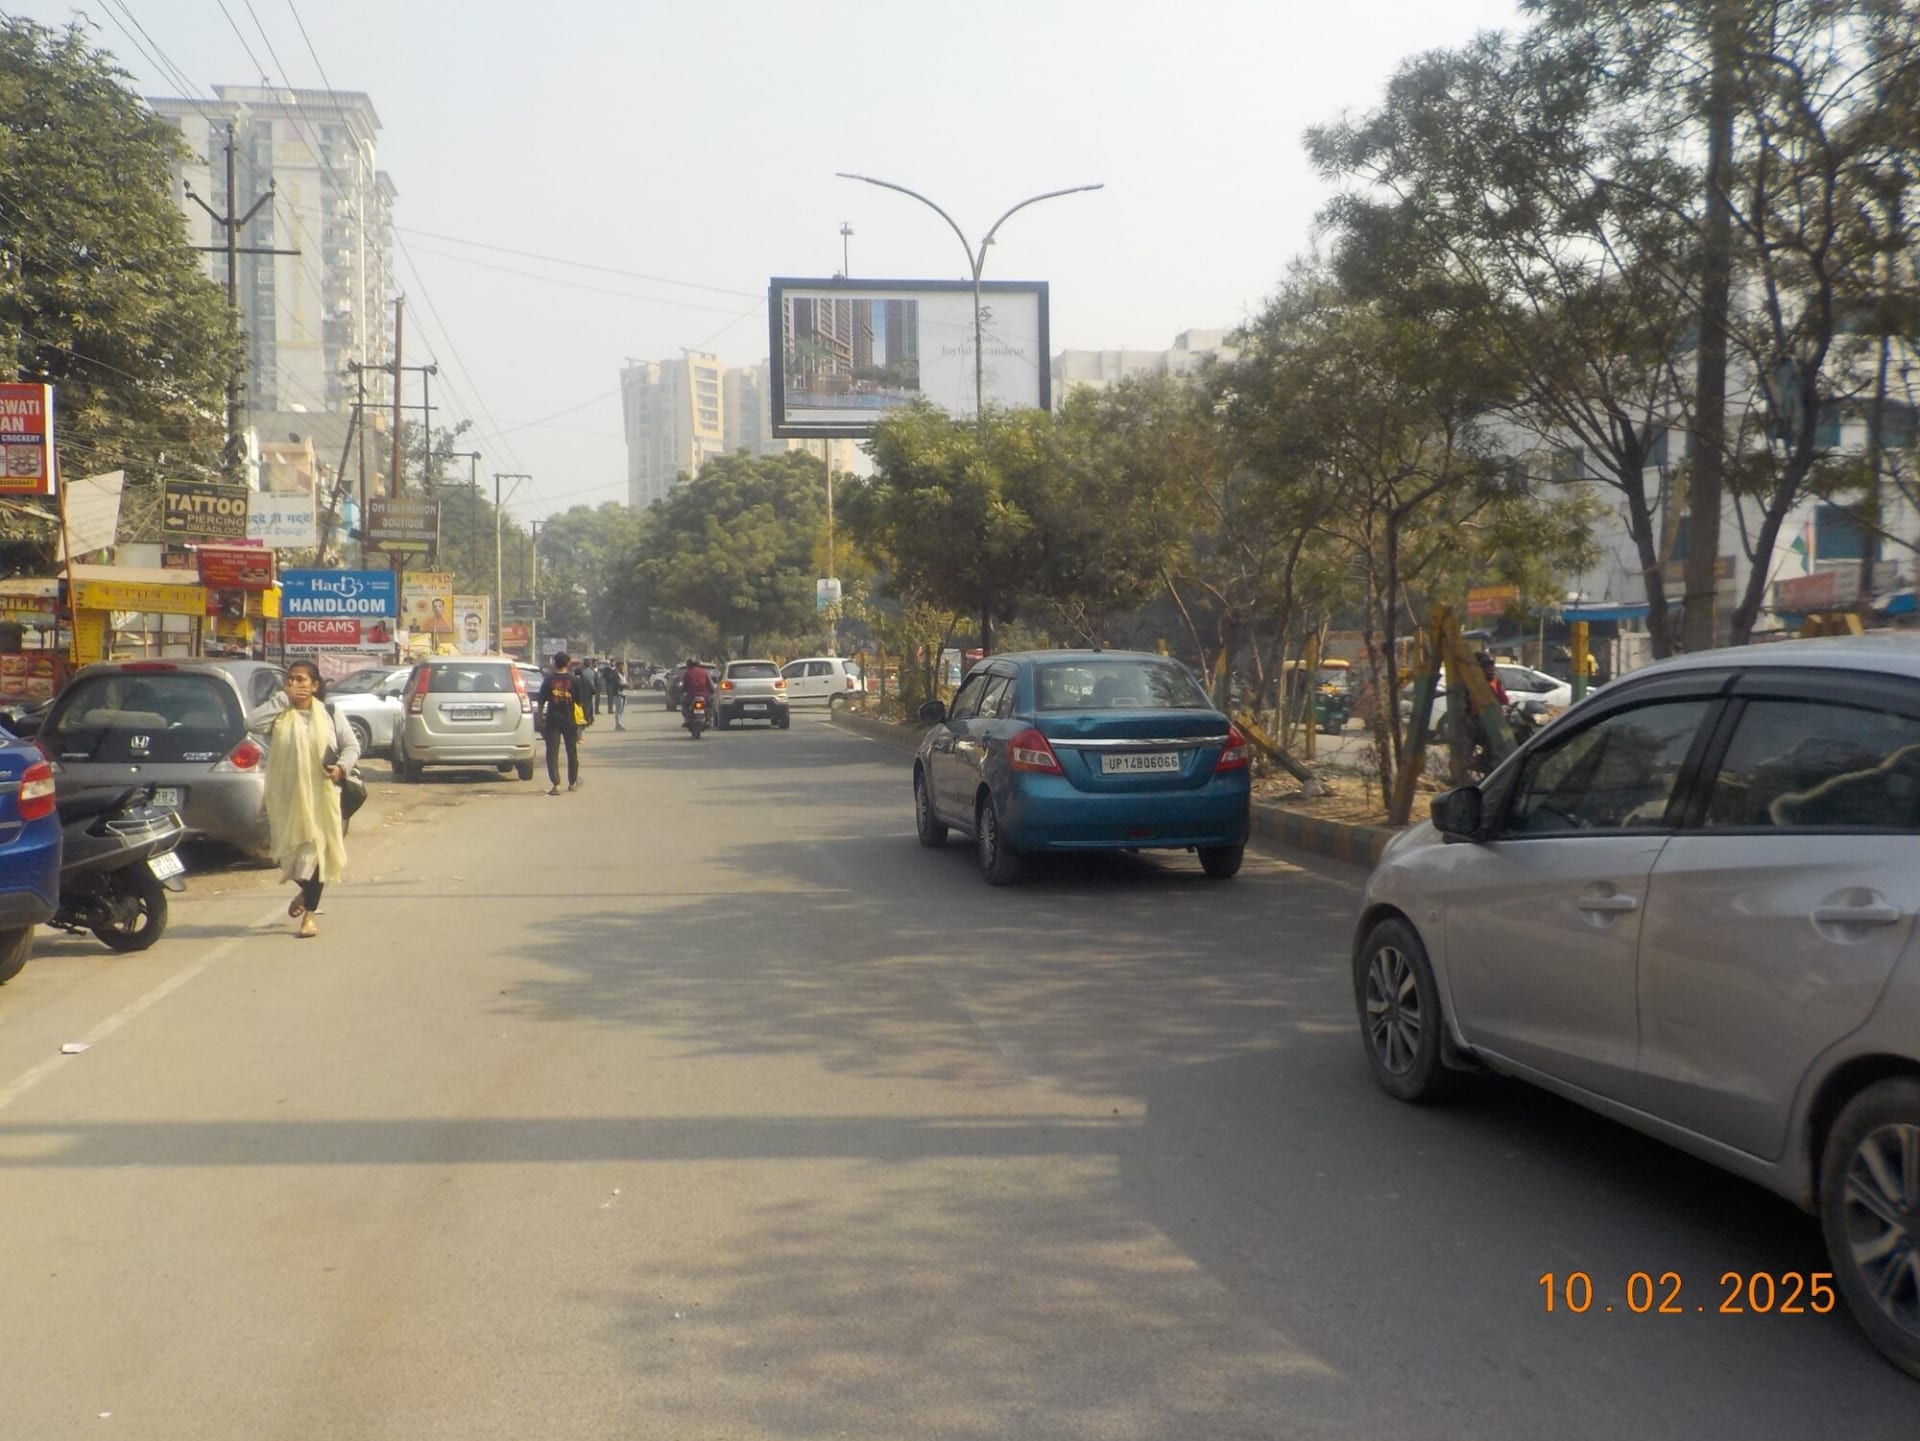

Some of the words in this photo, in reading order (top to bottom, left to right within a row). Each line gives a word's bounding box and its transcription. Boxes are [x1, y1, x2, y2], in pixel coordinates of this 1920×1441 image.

[167, 493, 246, 516] TATTOO
[371, 502, 385, 513] OM
[187, 514, 245, 526] PIERCING
[382, 517, 425, 529] BOUTIQUE
[186, 523, 244, 536] DREADLOCK
[289, 598, 386, 613] HANDLOOM
[298, 620, 356, 633] DREAMS
